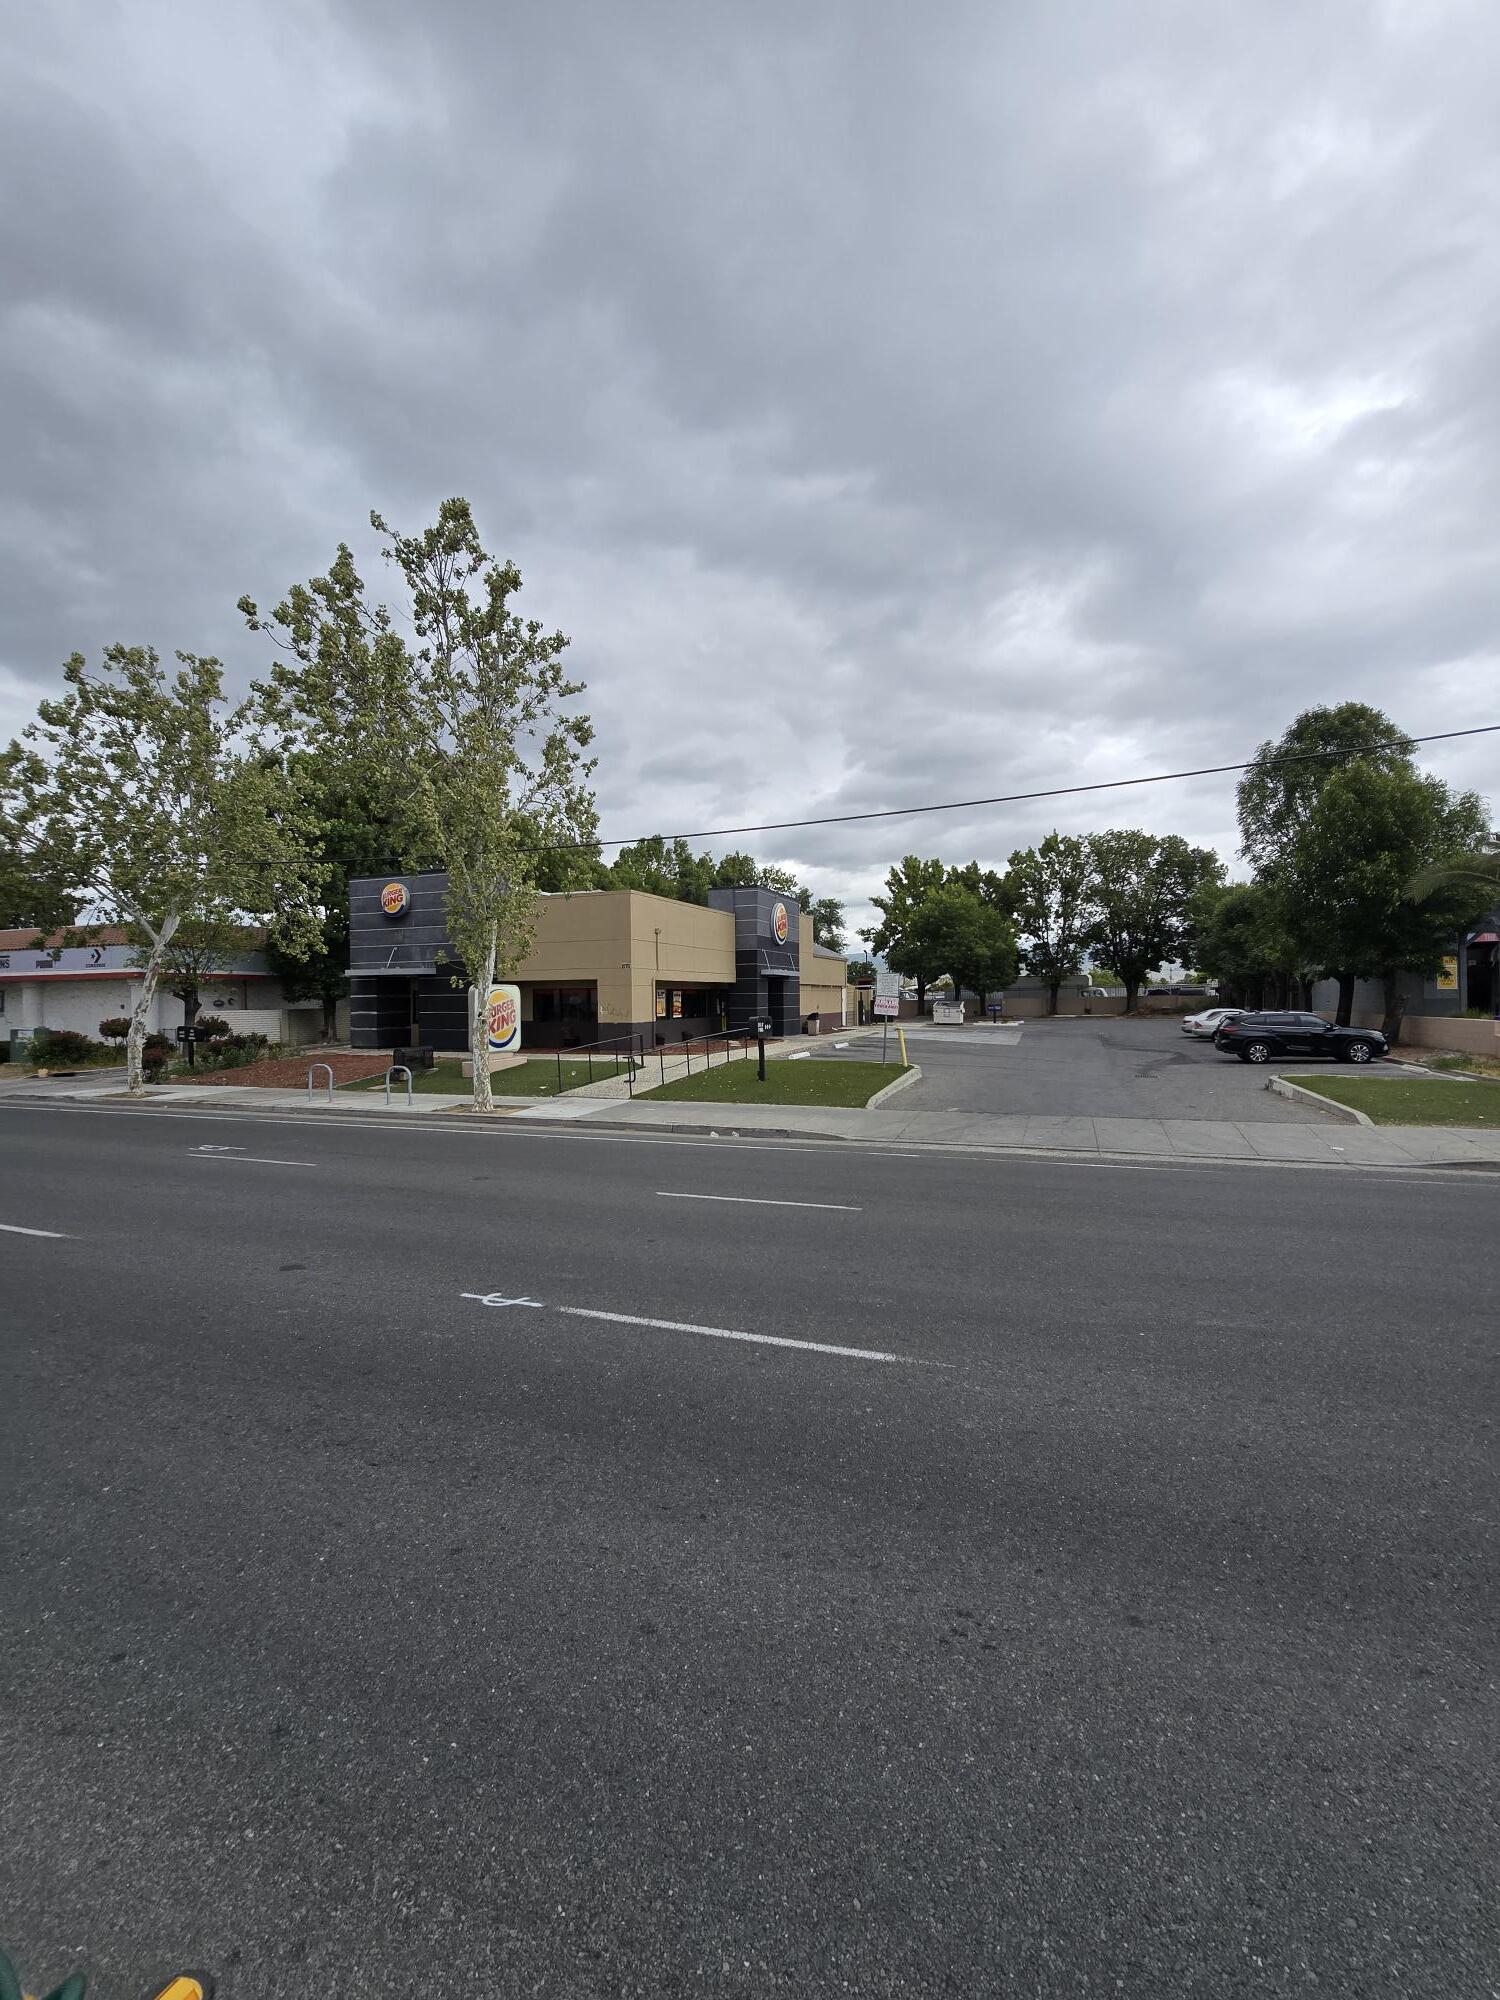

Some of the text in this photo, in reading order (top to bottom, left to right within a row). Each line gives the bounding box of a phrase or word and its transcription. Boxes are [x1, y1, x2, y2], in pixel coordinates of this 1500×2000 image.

[383, 888, 402, 898] BURGER
[383, 894, 404, 907] KING
[488, 1009, 516, 1034] KING
